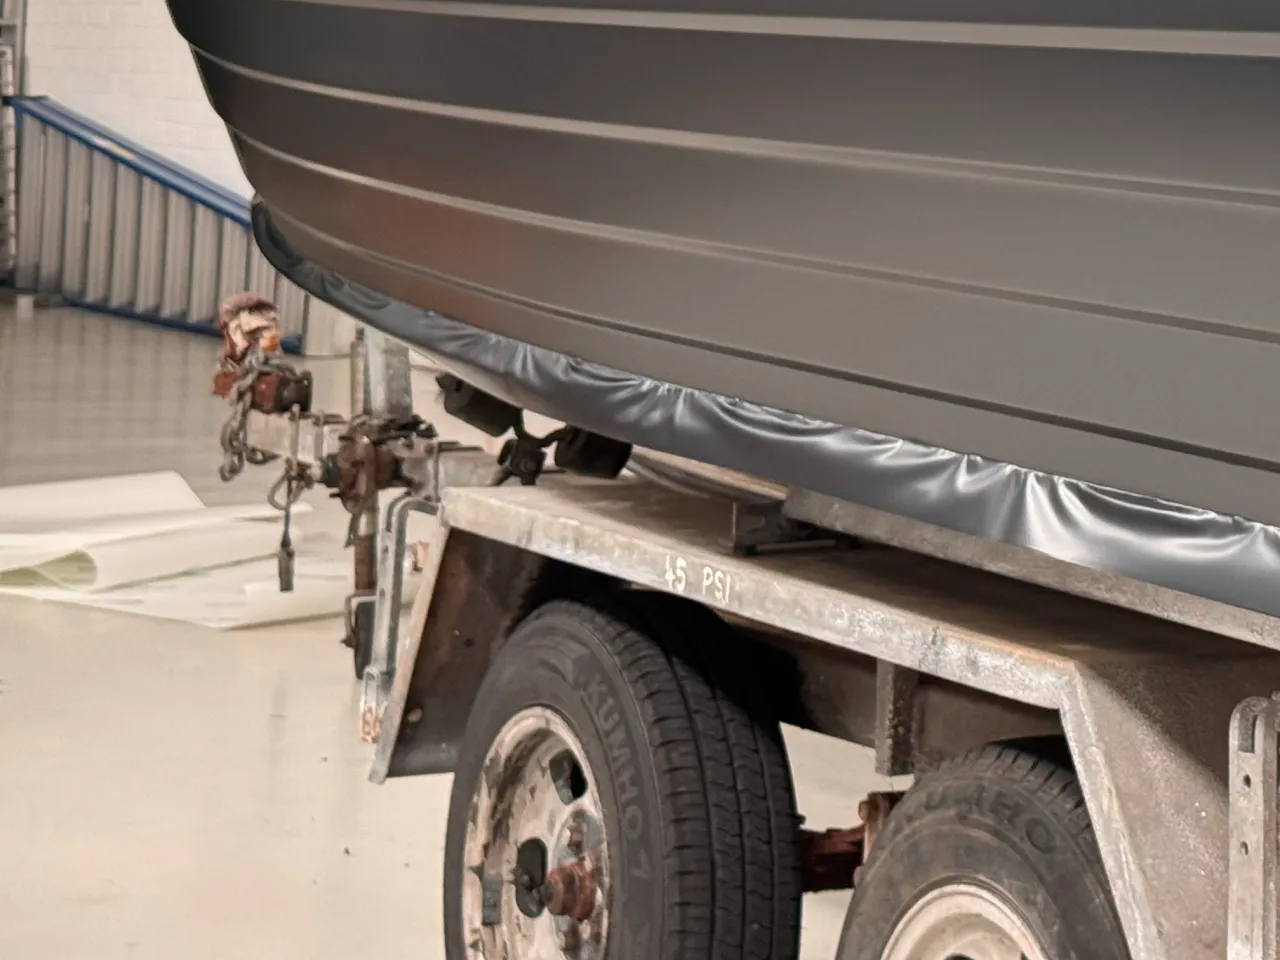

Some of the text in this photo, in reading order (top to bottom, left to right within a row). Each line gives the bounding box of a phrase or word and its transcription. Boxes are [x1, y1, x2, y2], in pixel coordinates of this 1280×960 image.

[665, 555, 731, 604] 45 PSI
[580, 674, 643, 839] KUMHO
